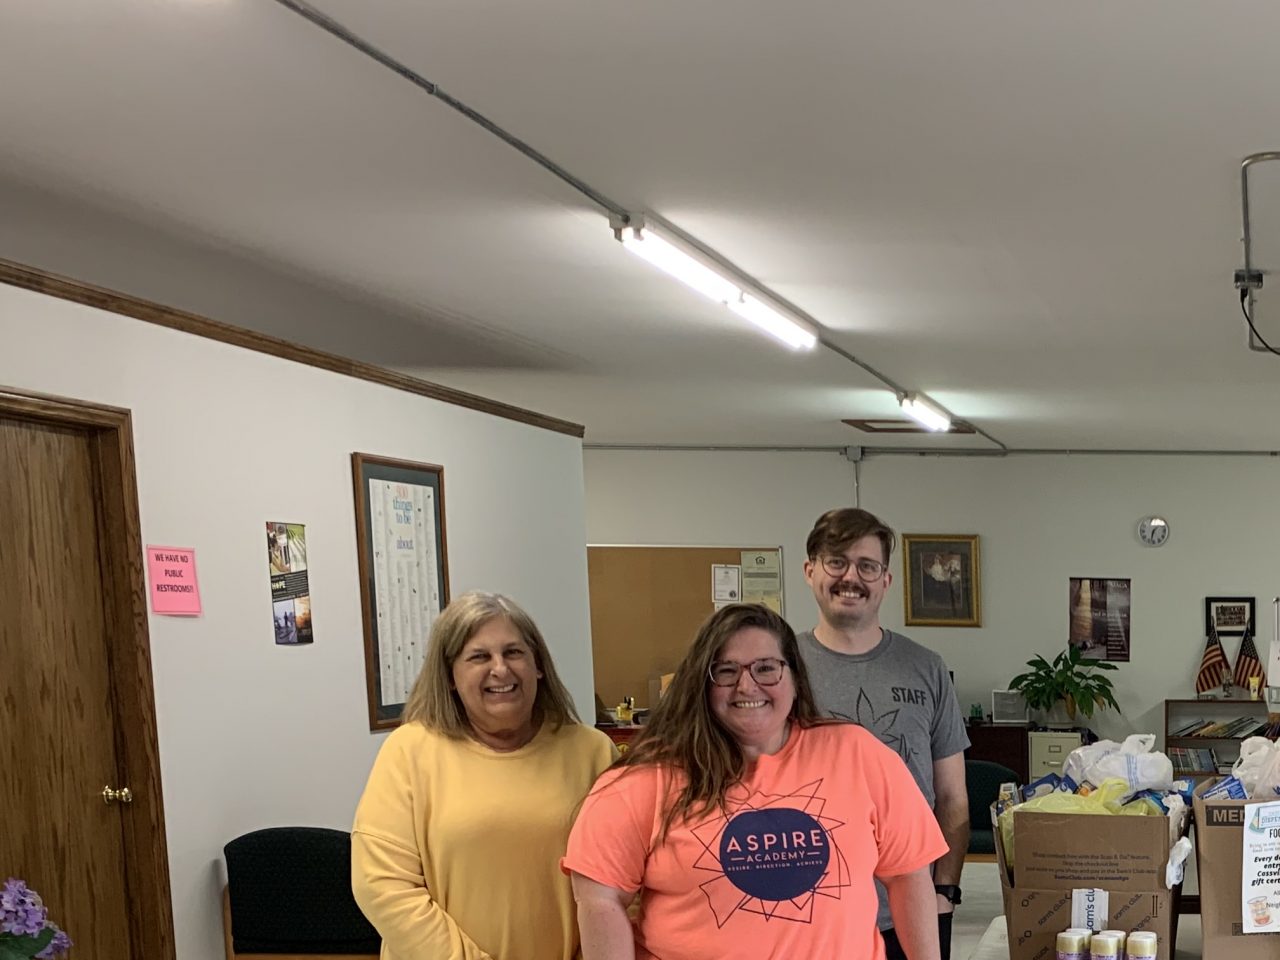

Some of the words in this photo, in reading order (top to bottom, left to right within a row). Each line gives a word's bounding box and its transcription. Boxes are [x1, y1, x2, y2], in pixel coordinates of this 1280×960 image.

[155, 554, 164, 562] WE
[165, 554, 179, 562] HAVE
[164, 569, 183, 577] PUBLIC
[891, 687, 926, 706] STAFF
[726, 829, 824, 853] ASPIRE
[747, 850, 805, 862] ACADEMY
[1038, 911, 1053, 925] sam's
[1053, 898, 1066, 912] club
[1086, 904, 1095, 931] sam's
[1114, 906, 1128, 920] sam's
